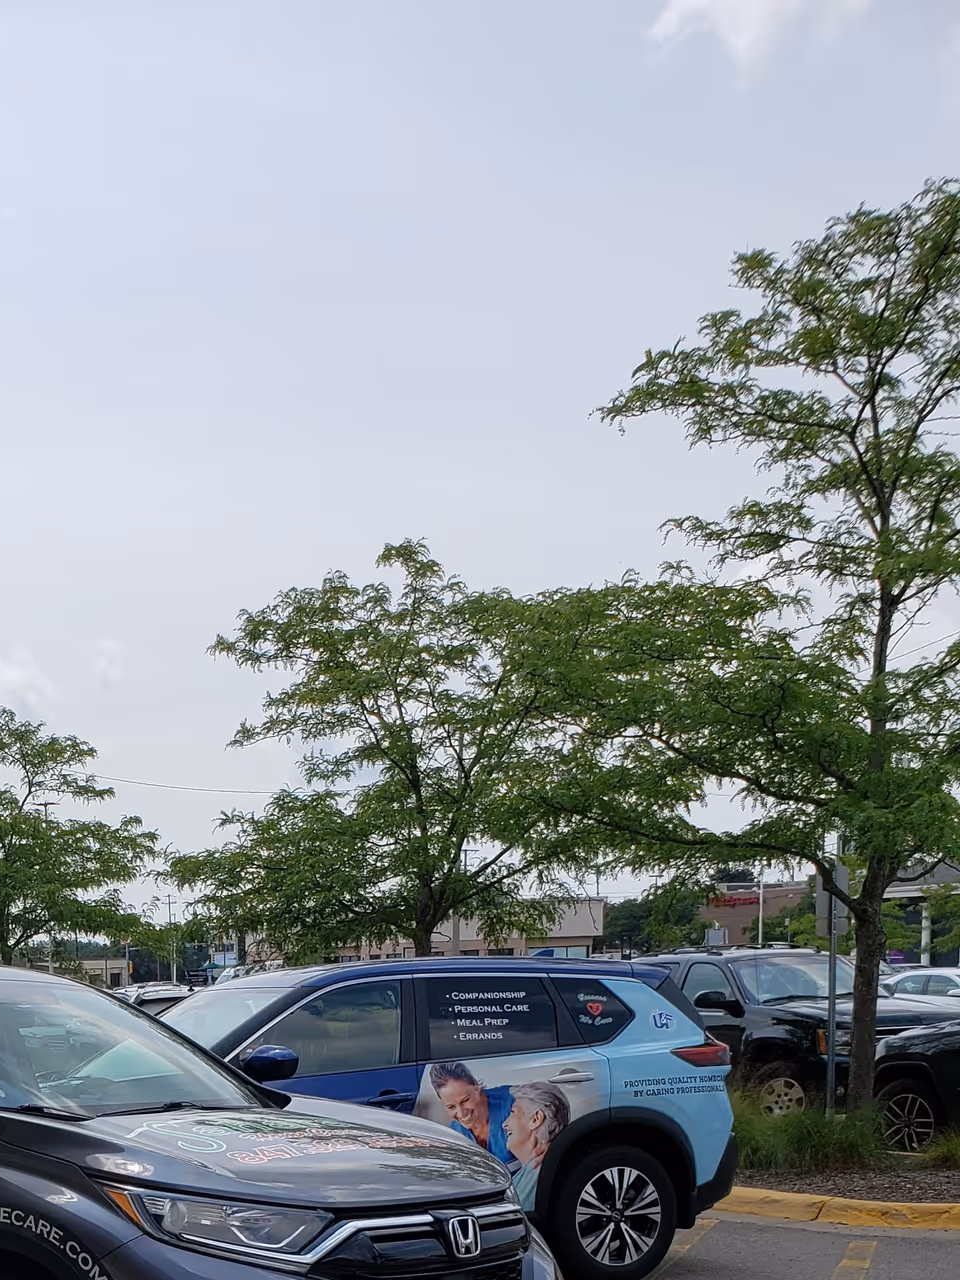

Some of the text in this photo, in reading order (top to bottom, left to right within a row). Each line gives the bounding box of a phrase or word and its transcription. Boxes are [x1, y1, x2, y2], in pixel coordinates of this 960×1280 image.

[451, 991, 526, 1000] COMPANIONSHIP
[454, 1004, 530, 1013] PERSONAL CARE
[456, 1018, 509, 1027] MEAL PREP
[459, 1032, 503, 1041] ERRANDS
[623, 1077, 666, 1088] PROVIDING
[667, 1075, 698, 1086] QUALITY
[633, 1085, 725, 1098] BY CARING PROFESSIONALS
